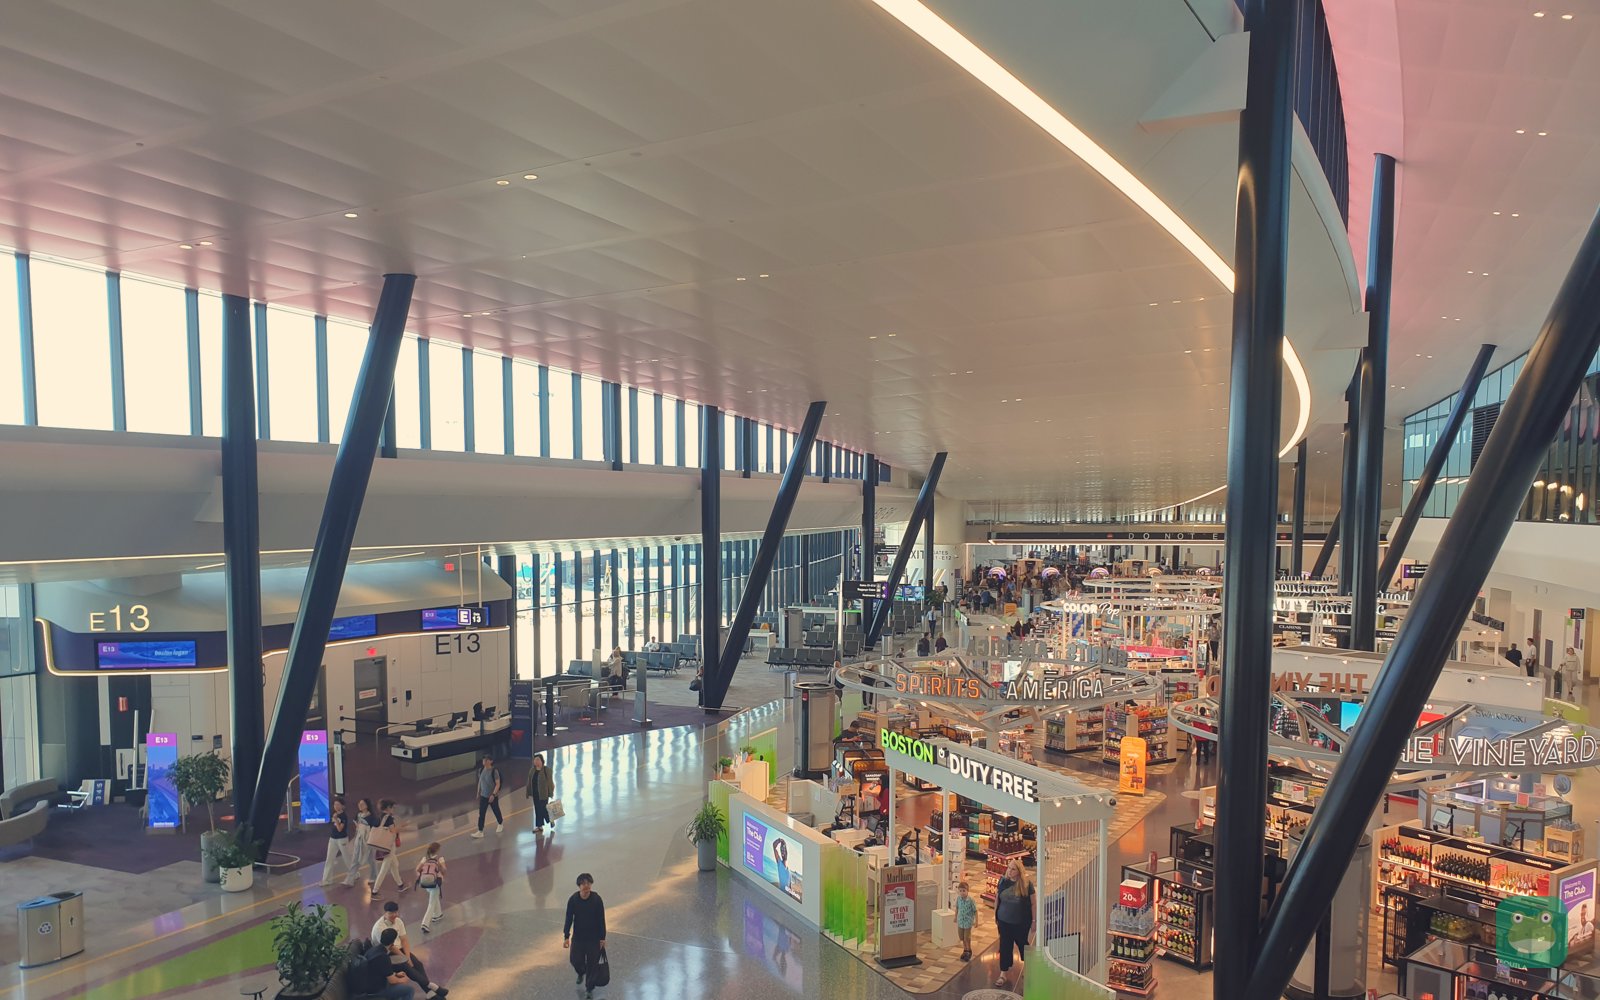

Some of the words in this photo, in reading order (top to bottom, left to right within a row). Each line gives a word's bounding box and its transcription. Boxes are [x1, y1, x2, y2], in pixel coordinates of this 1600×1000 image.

[1128, 532, 1150, 540] DO
[1164, 532, 1195, 540] NOT
[89, 604, 151, 632] E13
[459, 610, 469, 623] E
[472, 615, 482, 623] 13
[1063, 602, 1098, 614] COLOR
[1099, 601, 1121, 621] Pop
[435, 633, 481, 655] E13
[895, 673, 980, 698] SPIRITS
[1006, 679, 1104, 701] AMERICA
[155, 736, 168, 744] E13
[1449, 735, 1598, 766] VINEYARD
[880, 728, 934, 765] BOSTON
[950, 753, 990, 786] DUTY
[992, 768, 1037, 803] FREE
[1564, 890, 1574, 900] The
[1574, 884, 1586, 896] Club
[1481, 899, 1496, 907] RUM
[1495, 957, 1528, 971] TEQUILA
